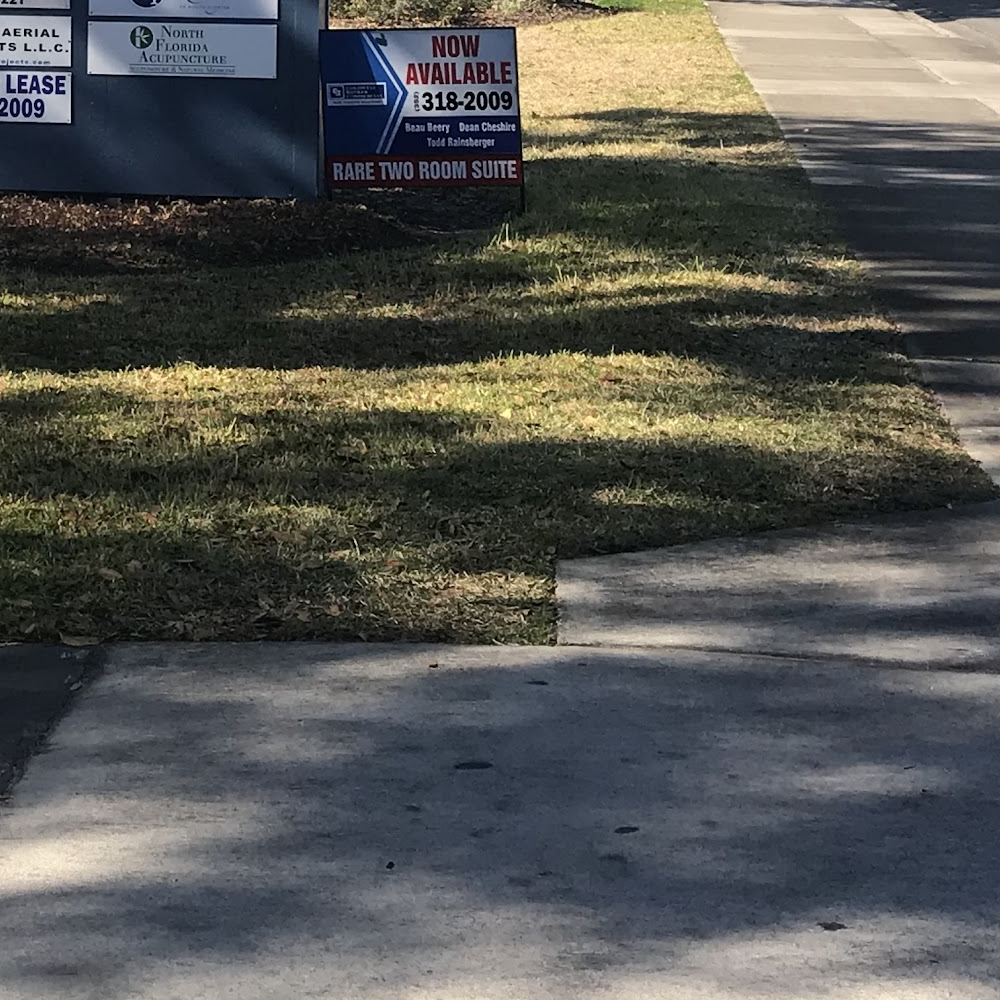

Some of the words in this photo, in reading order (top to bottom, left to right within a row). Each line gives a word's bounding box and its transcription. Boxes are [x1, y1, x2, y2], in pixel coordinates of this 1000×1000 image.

[2, 28, 60, 38] AERIAL
[161, 25, 204, 38] NORTH
[24, 43, 69, 53] L.L.C.
[156, 39, 208, 52] FLORIDA
[431, 35, 480, 58] NOW
[139, 51, 227, 64] ACUPUNCTURE
[406, 62, 512, 85] AVAILABLE
[6, 75, 66, 95] LEASE
[422, 91, 513, 111] 318-2009
[405, 123, 425, 132] Beau
[427, 122, 450, 133] Beery
[459, 122, 480, 132] Dean
[481, 122, 516, 132] Cheshire
[427, 137, 446, 147] Todd
[447, 137, 495, 149] Rainsberger
[333, 162, 375, 180] RARE
[379, 162, 414, 180] TWO
[419, 161, 466, 179] ROOM
[472, 160, 517, 179] SUITE
